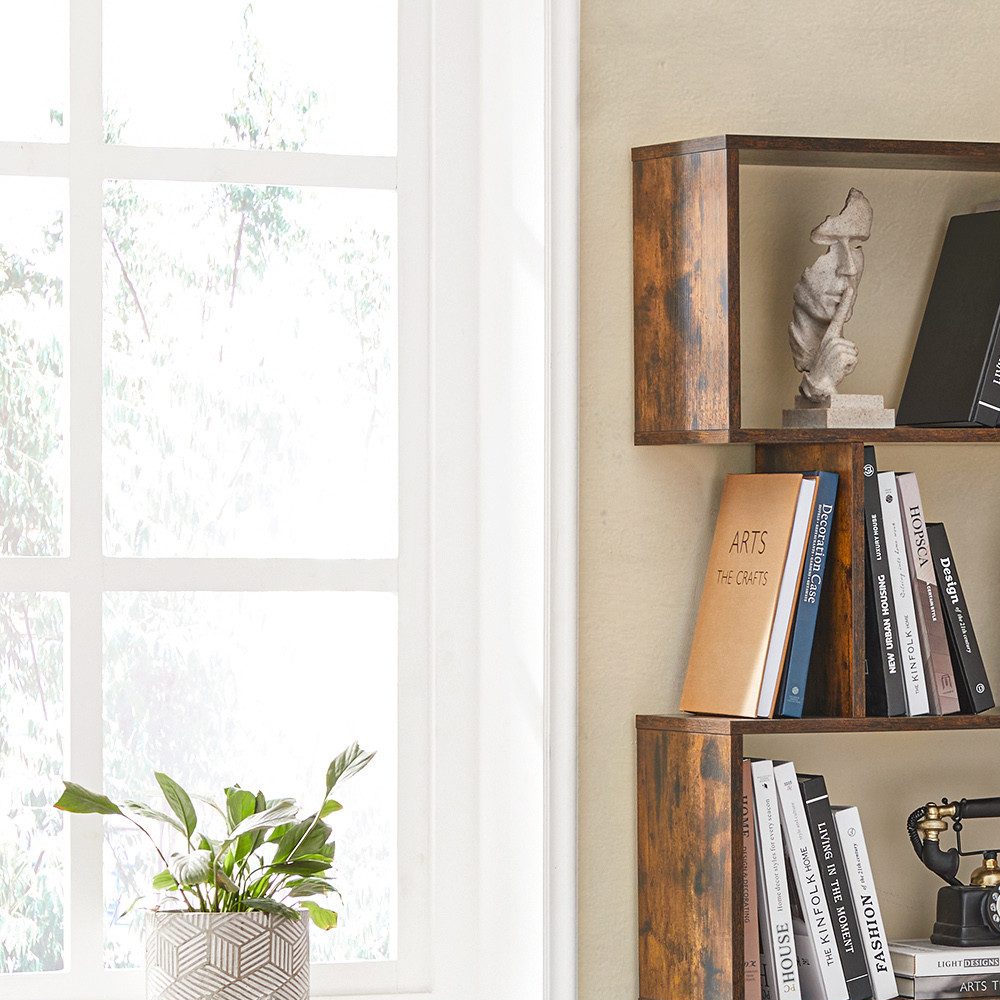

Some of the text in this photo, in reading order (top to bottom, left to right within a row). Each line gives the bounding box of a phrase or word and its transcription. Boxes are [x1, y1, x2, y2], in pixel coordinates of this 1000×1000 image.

[728, 530, 768, 555] ARTS
[812, 503, 833, 572] Decoration
[871, 513, 882, 561] LUXURY HOUSE
[909, 505, 929, 567] HOPSCA
[717, 569, 769, 586] THE CRAFTS
[807, 574, 822, 604] Case
[940, 557, 959, 605] Design
[877, 574, 896, 674] NEW URBAN HOUSING
[905, 630, 920, 682] KINFOLK
[800, 846, 834, 966] THE KINFOLK HOME
[818, 822, 854, 954] LIVING IN THE MOMENT
[776, 923, 795, 983] HOUSE
[860, 894, 888, 973] FASHION
[937, 958, 999, 968] LIGHT DESIGNS
[960, 981, 987, 992] ARTS
